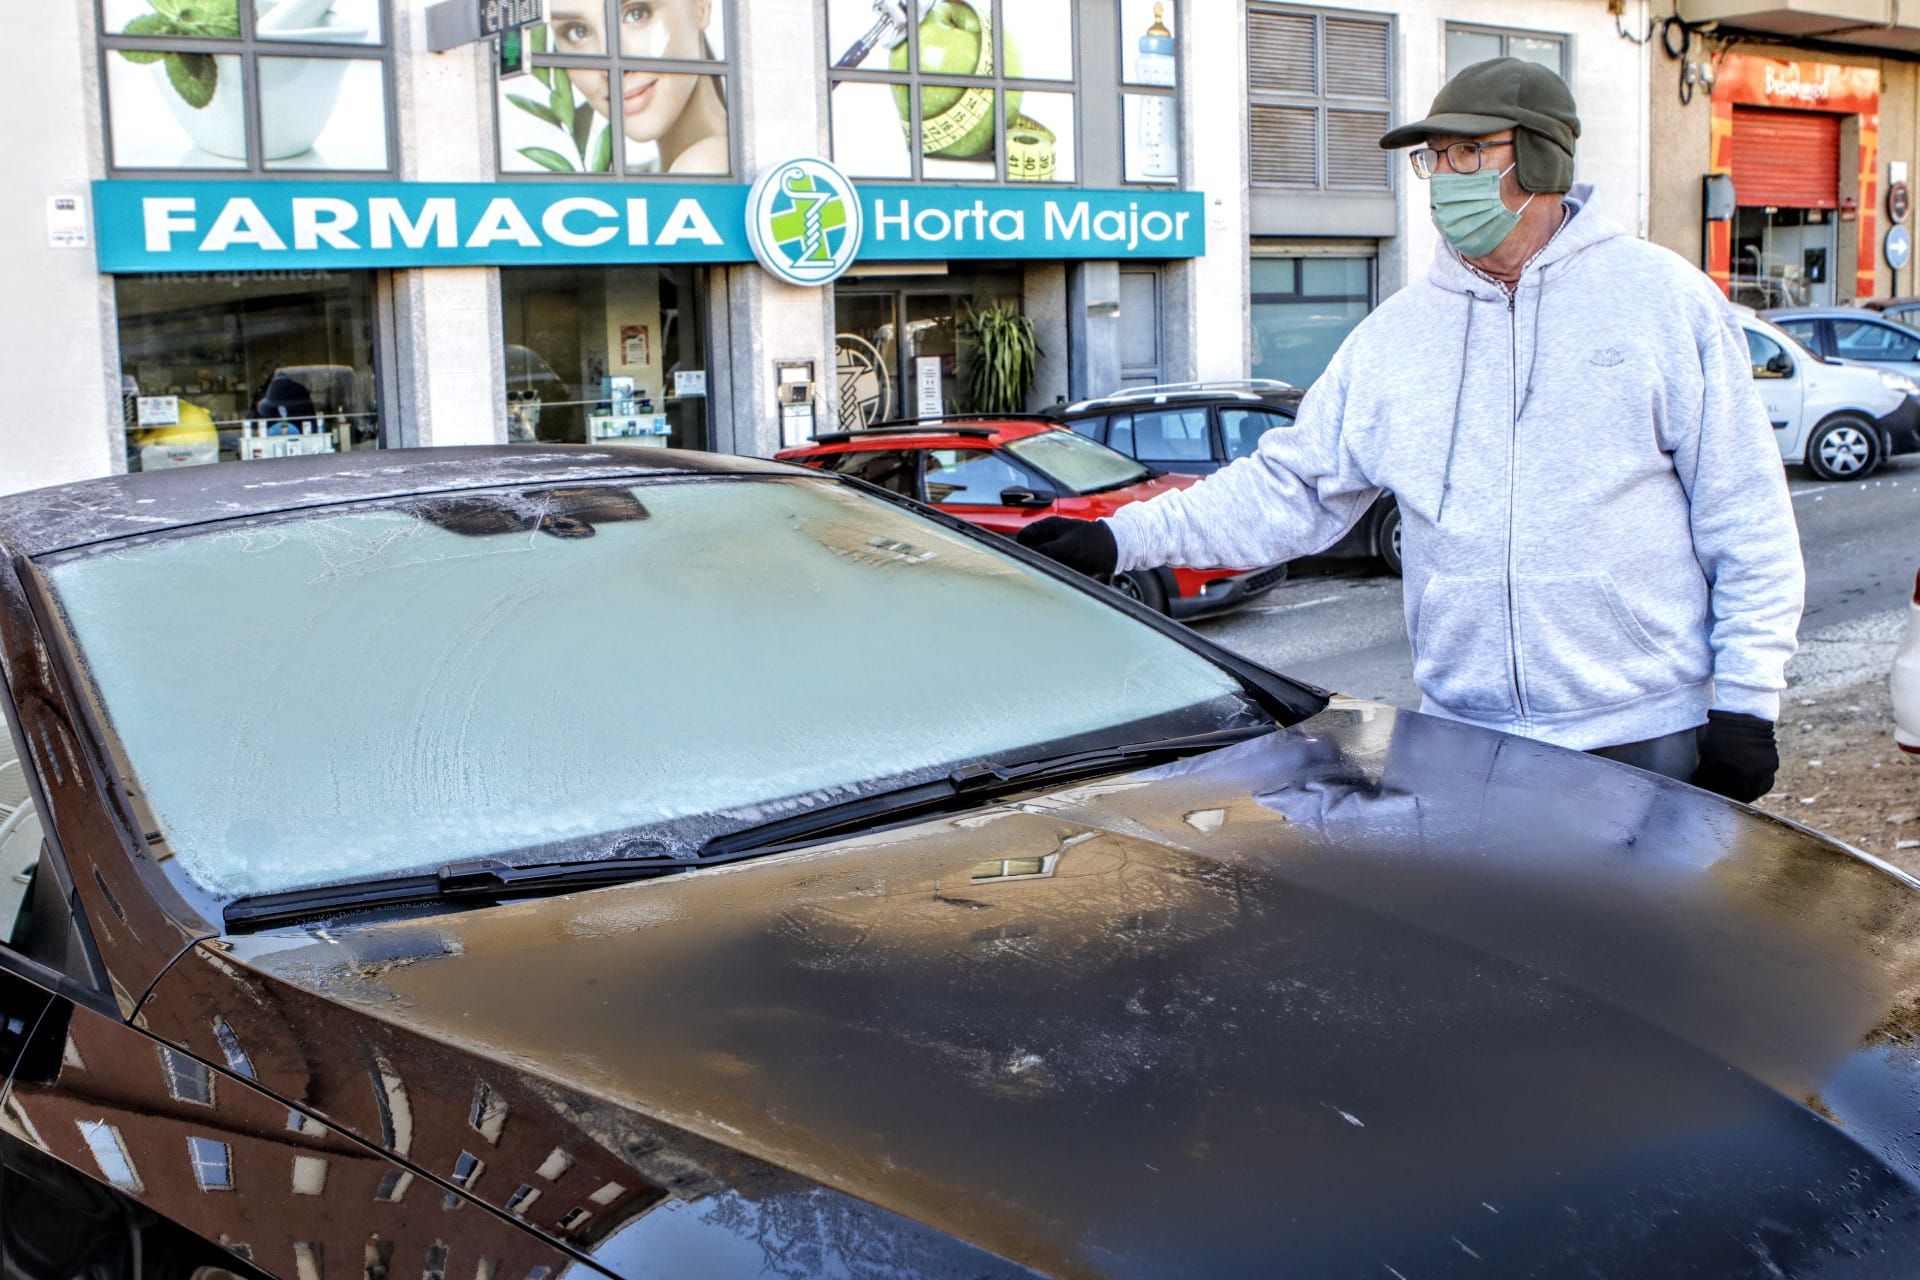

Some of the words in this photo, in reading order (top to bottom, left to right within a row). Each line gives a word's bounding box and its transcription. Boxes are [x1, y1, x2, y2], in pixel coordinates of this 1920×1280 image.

[1008, 154, 1020, 168] 41
[1024, 156, 1036, 171] 40
[143, 197, 724, 252] FARMACIA
[875, 200, 1026, 242] Horta
[1044, 202, 1191, 252] Major
